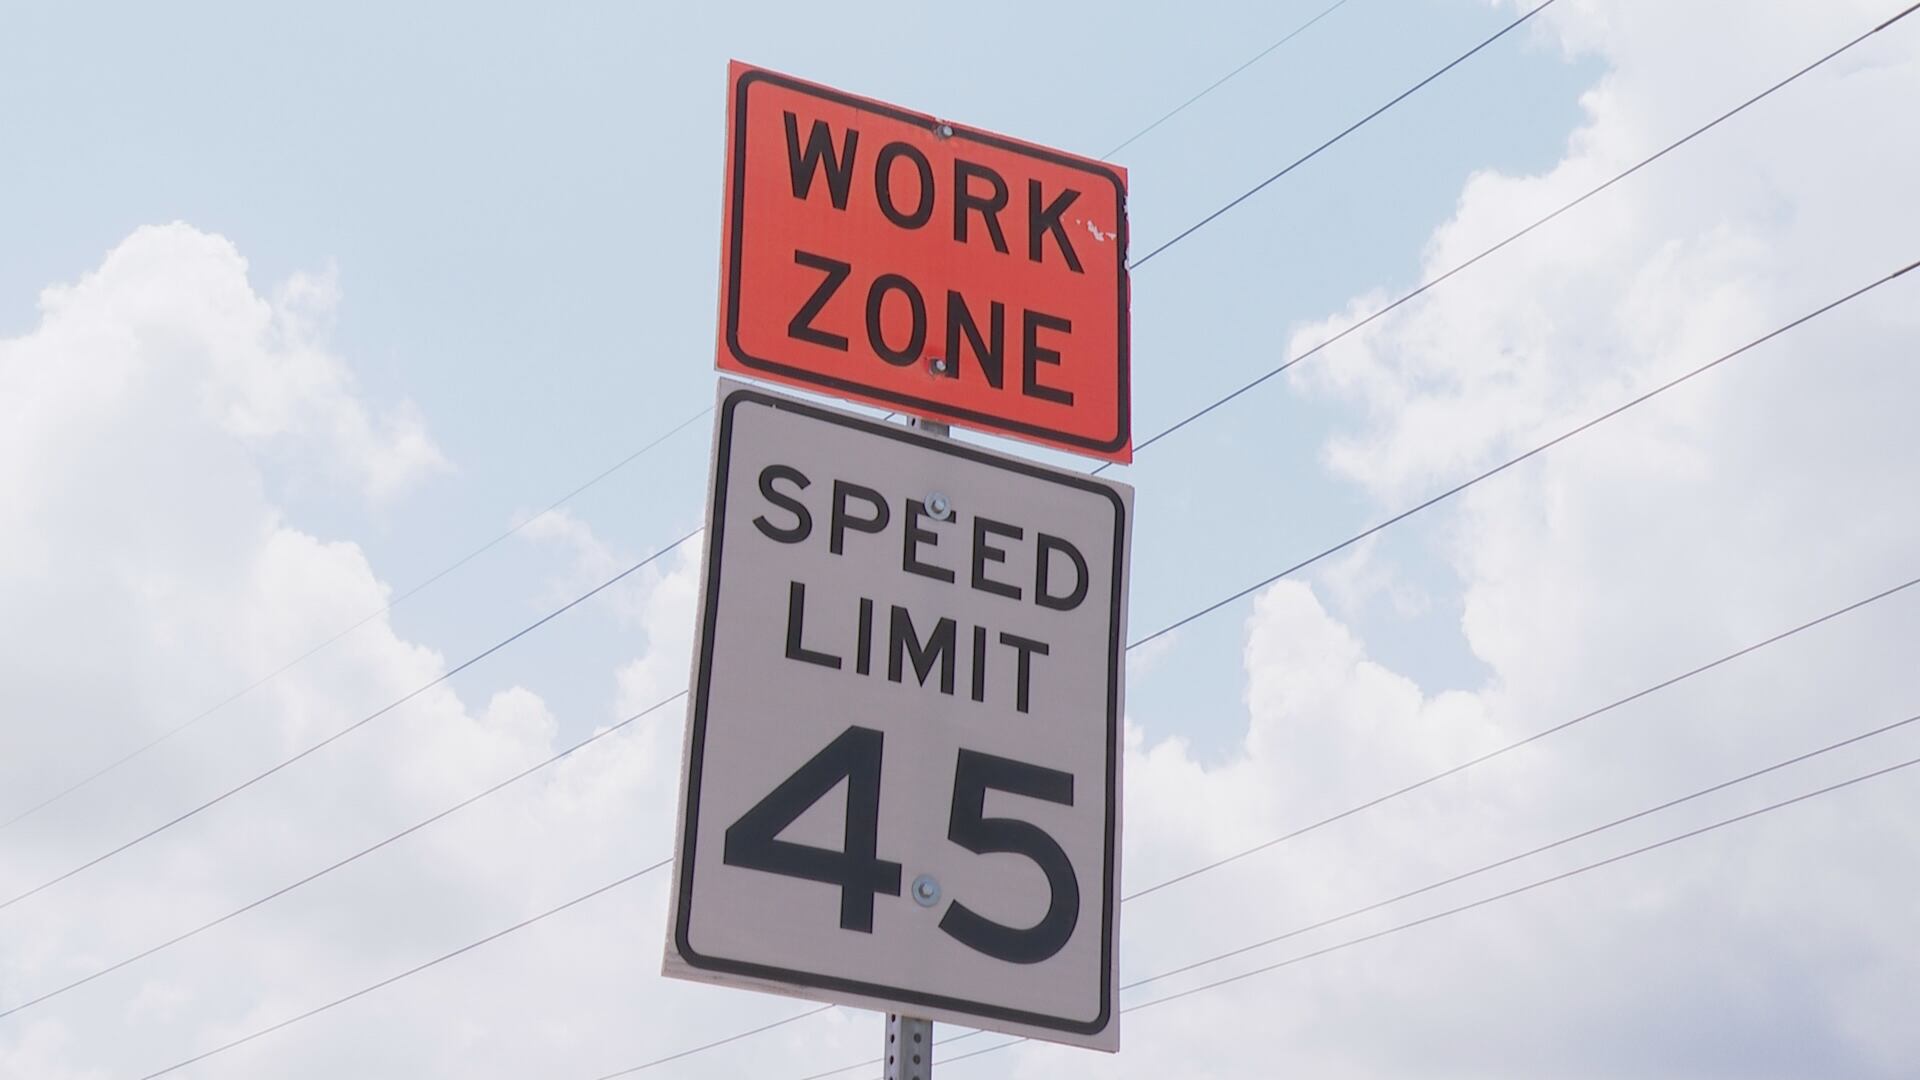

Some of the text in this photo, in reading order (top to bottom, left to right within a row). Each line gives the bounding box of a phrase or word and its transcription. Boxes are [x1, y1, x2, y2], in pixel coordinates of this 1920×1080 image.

[783, 110, 1085, 275] WORK
[787, 249, 1074, 407] ZONE
[752, 464, 1090, 612] SPEED
[785, 580, 1050, 714] LIMIT
[723, 724, 1081, 965] 45
